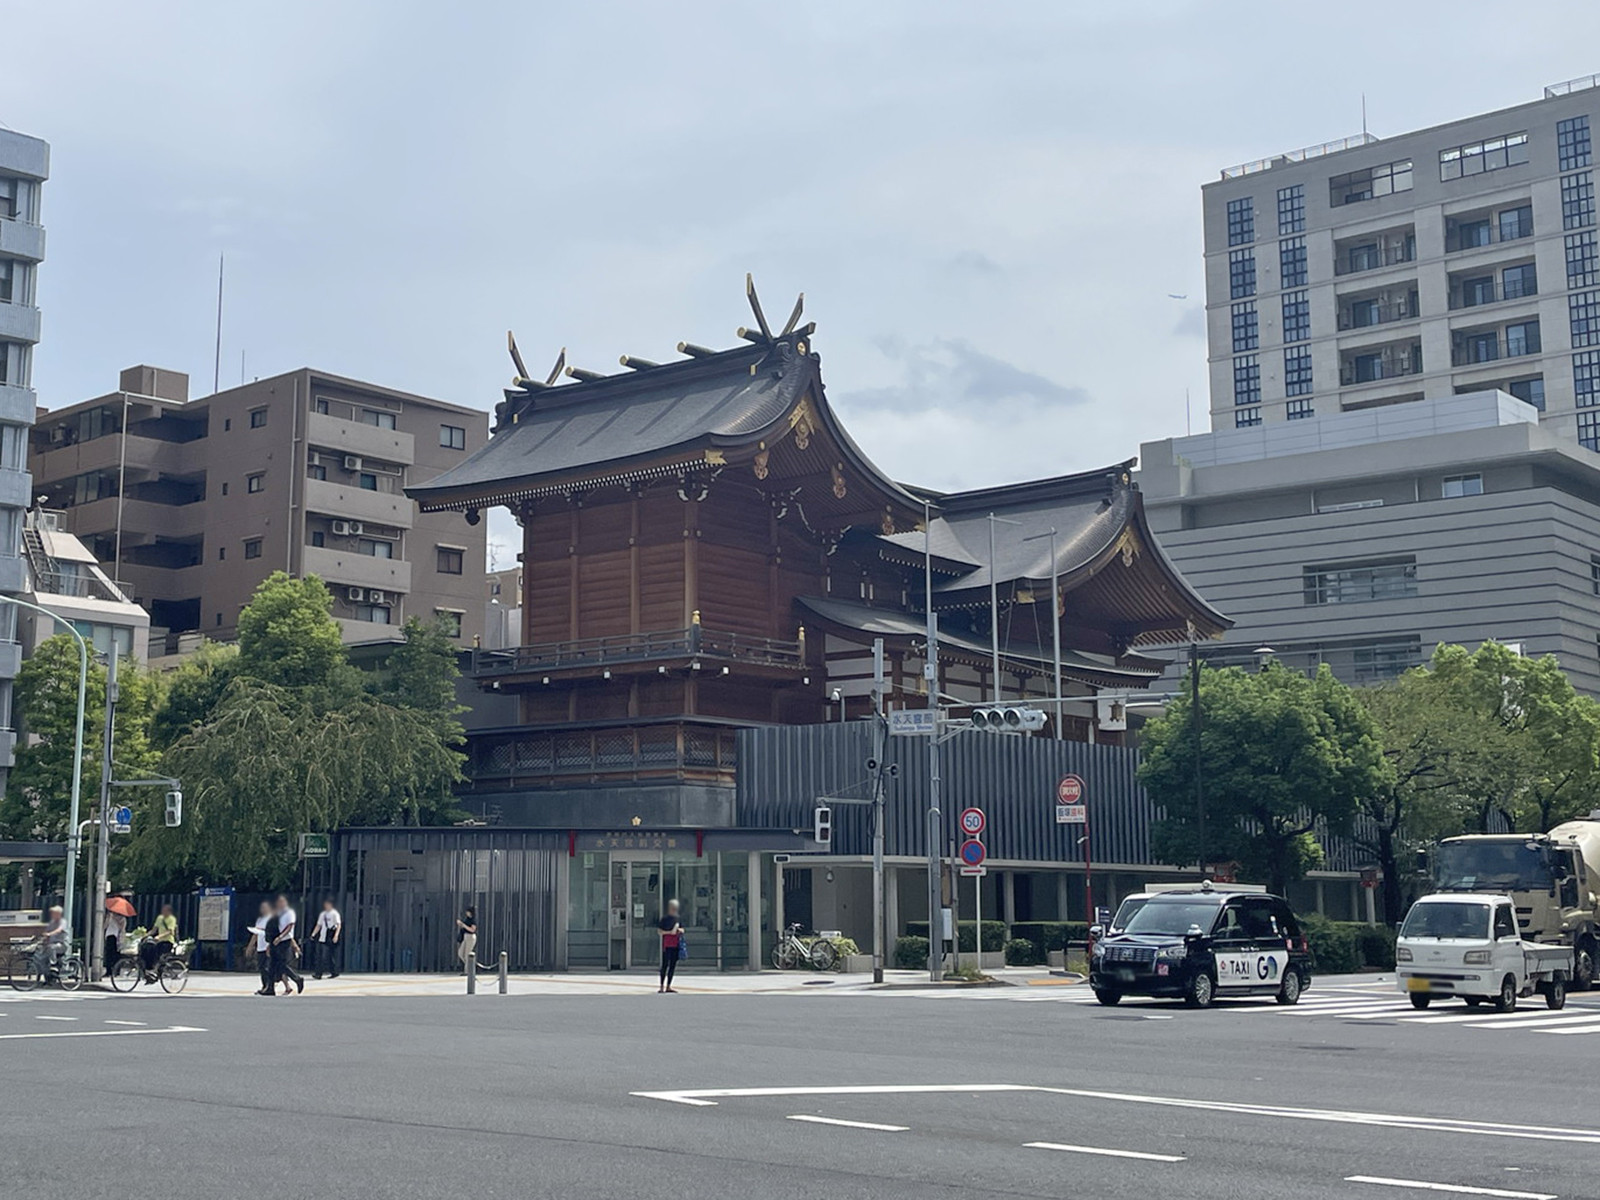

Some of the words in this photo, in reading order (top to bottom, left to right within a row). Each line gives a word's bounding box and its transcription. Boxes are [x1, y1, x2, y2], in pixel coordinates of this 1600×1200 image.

[893, 712, 933, 724] 水天宮前
[966, 815, 980, 828] 50
[1230, 960, 1250, 975] TAXI
[1257, 955, 1278, 980] GO
